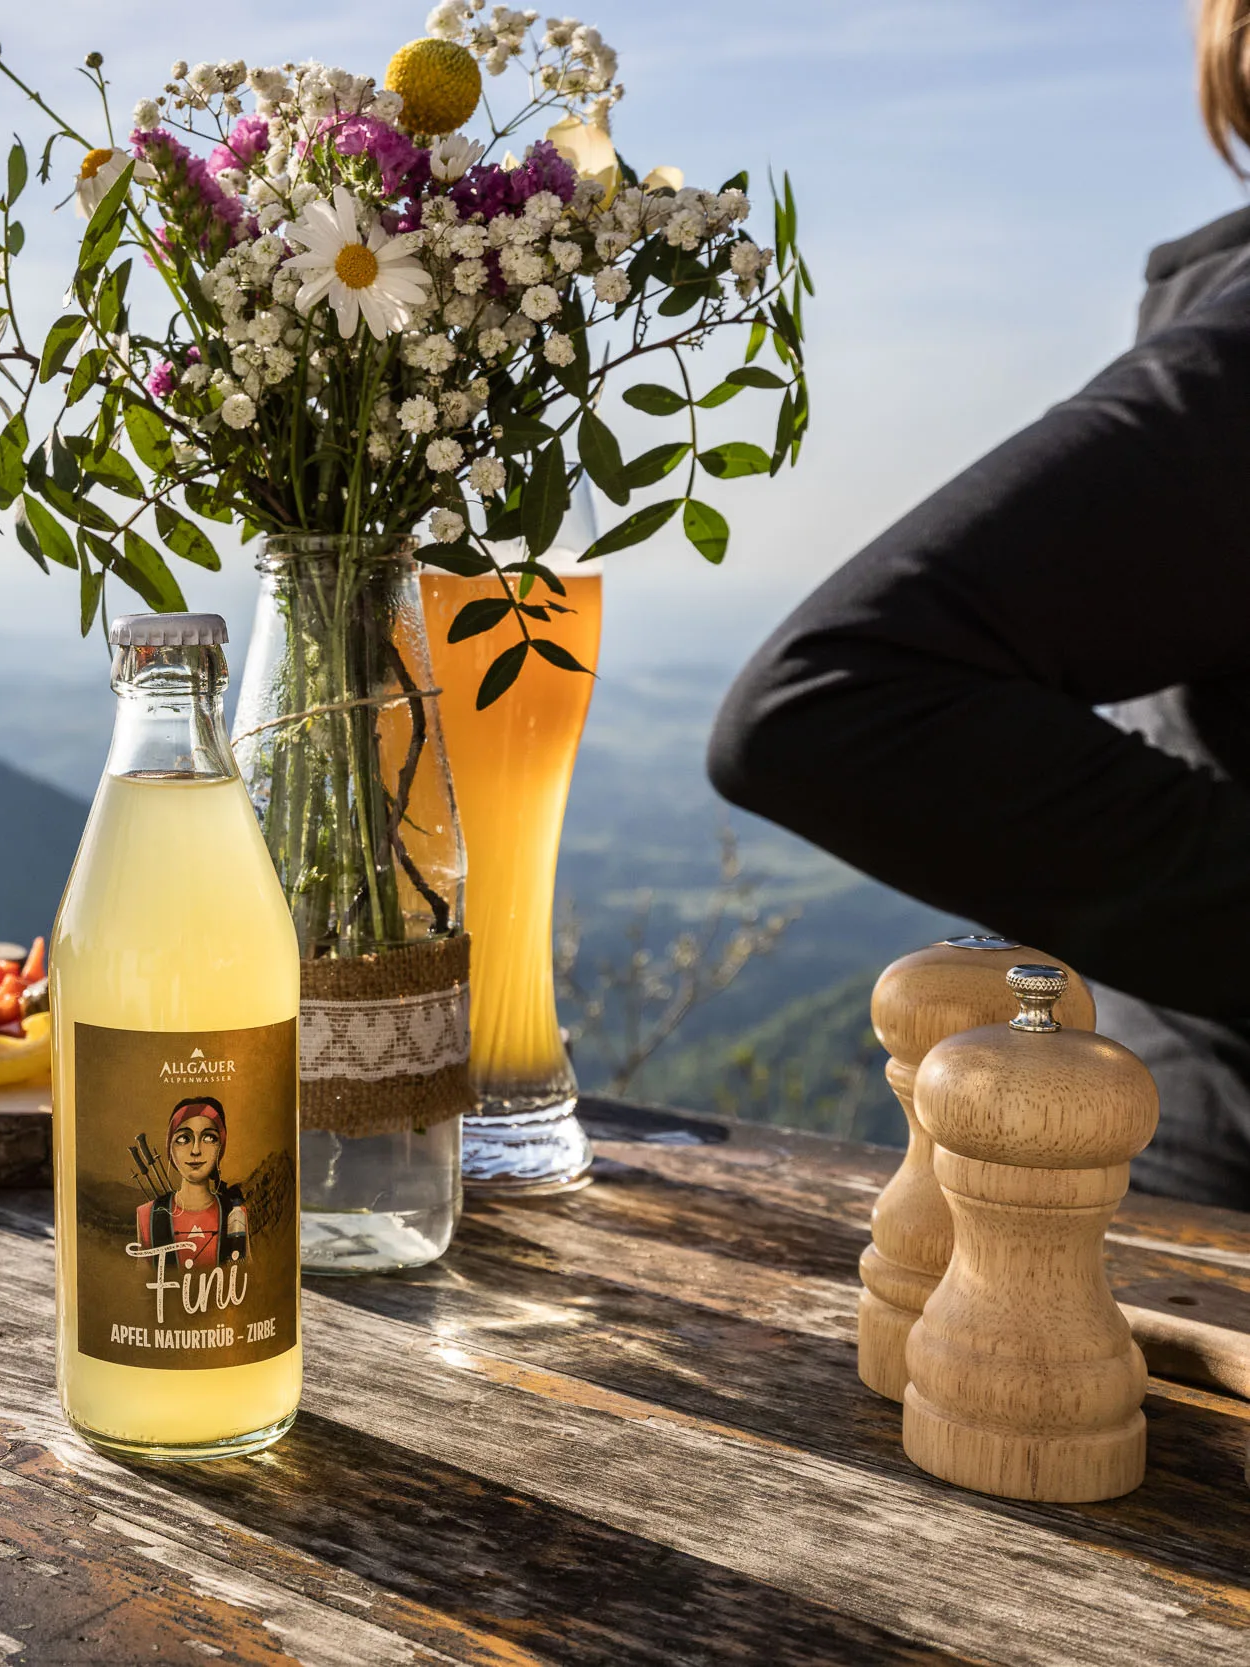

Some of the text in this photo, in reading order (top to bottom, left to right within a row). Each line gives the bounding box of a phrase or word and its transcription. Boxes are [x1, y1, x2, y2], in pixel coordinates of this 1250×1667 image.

[159, 1060, 236, 1078] ALLGÄUER
[163, 1075, 232, 1084] ALPENWASSER
[125, 1241, 248, 1324] Fini
[111, 1323, 151, 1348] APFEL
[154, 1324, 235, 1349] NATURTRÜB
[246, 1317, 276, 1343] ZIRBE
